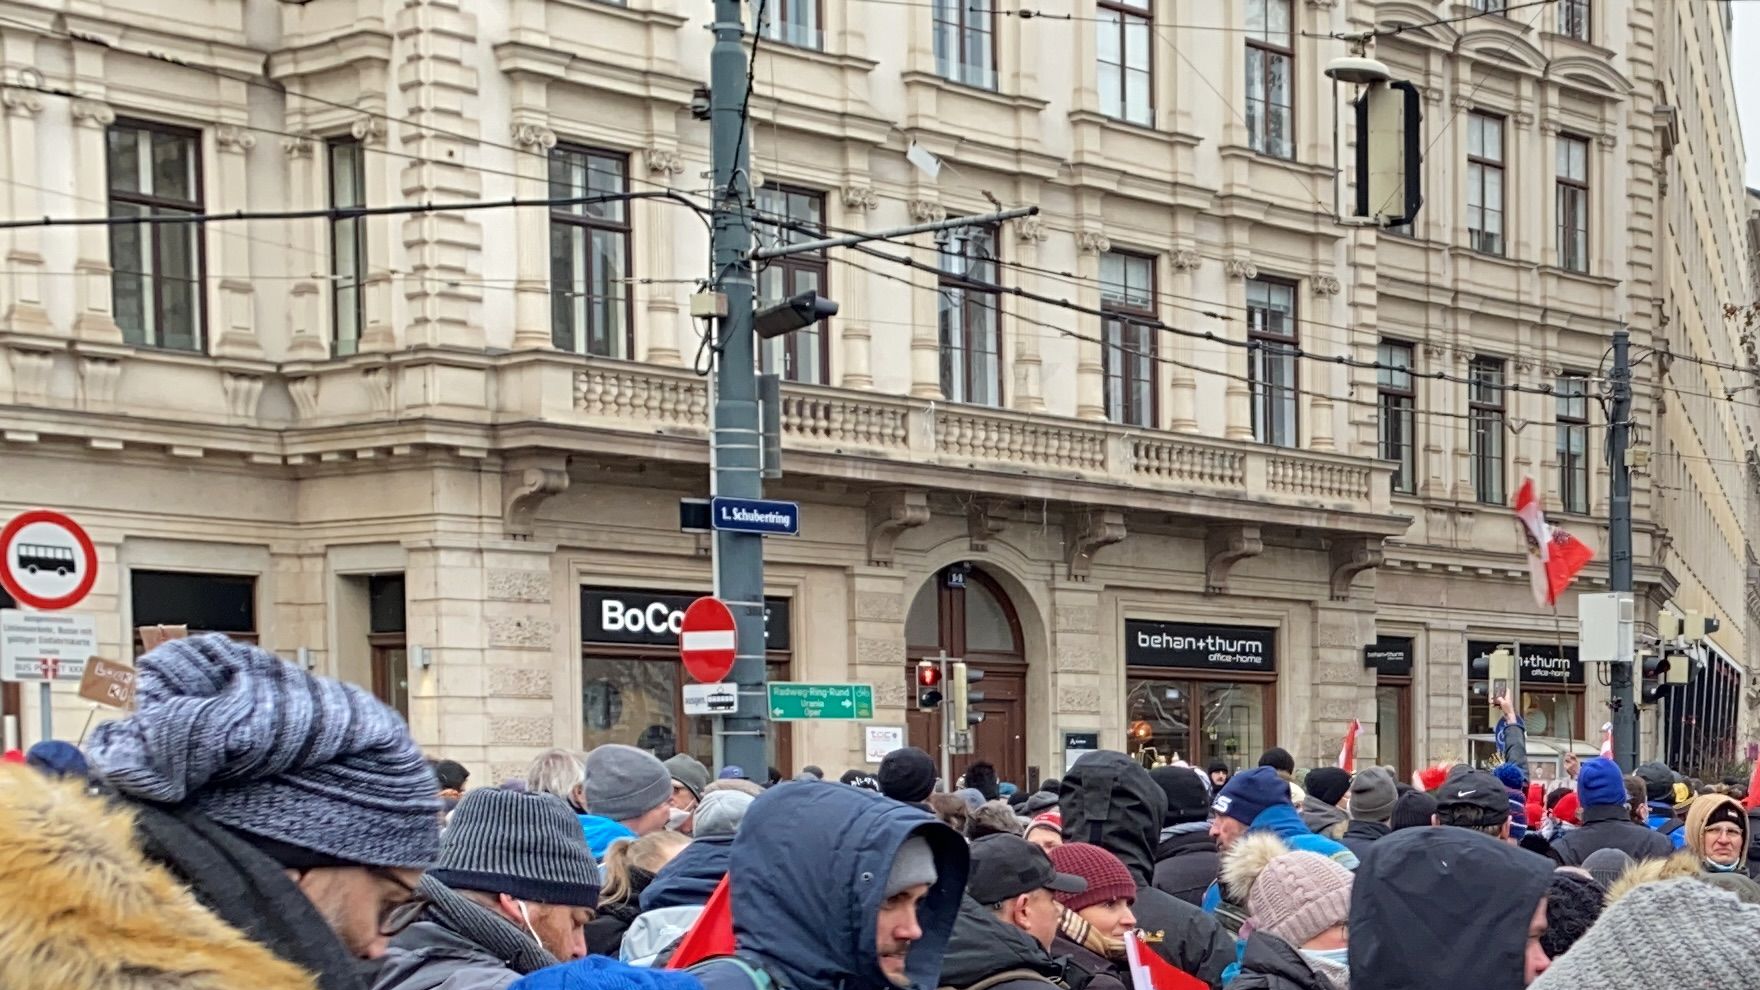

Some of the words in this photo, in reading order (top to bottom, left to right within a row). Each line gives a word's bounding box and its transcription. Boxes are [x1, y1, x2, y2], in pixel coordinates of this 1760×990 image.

[721, 506, 732, 520] 1.
[732, 507, 791, 527] Schubertring
[601, 599, 685, 634] BoCo
[1136, 630, 1263, 653] behan+thurm
